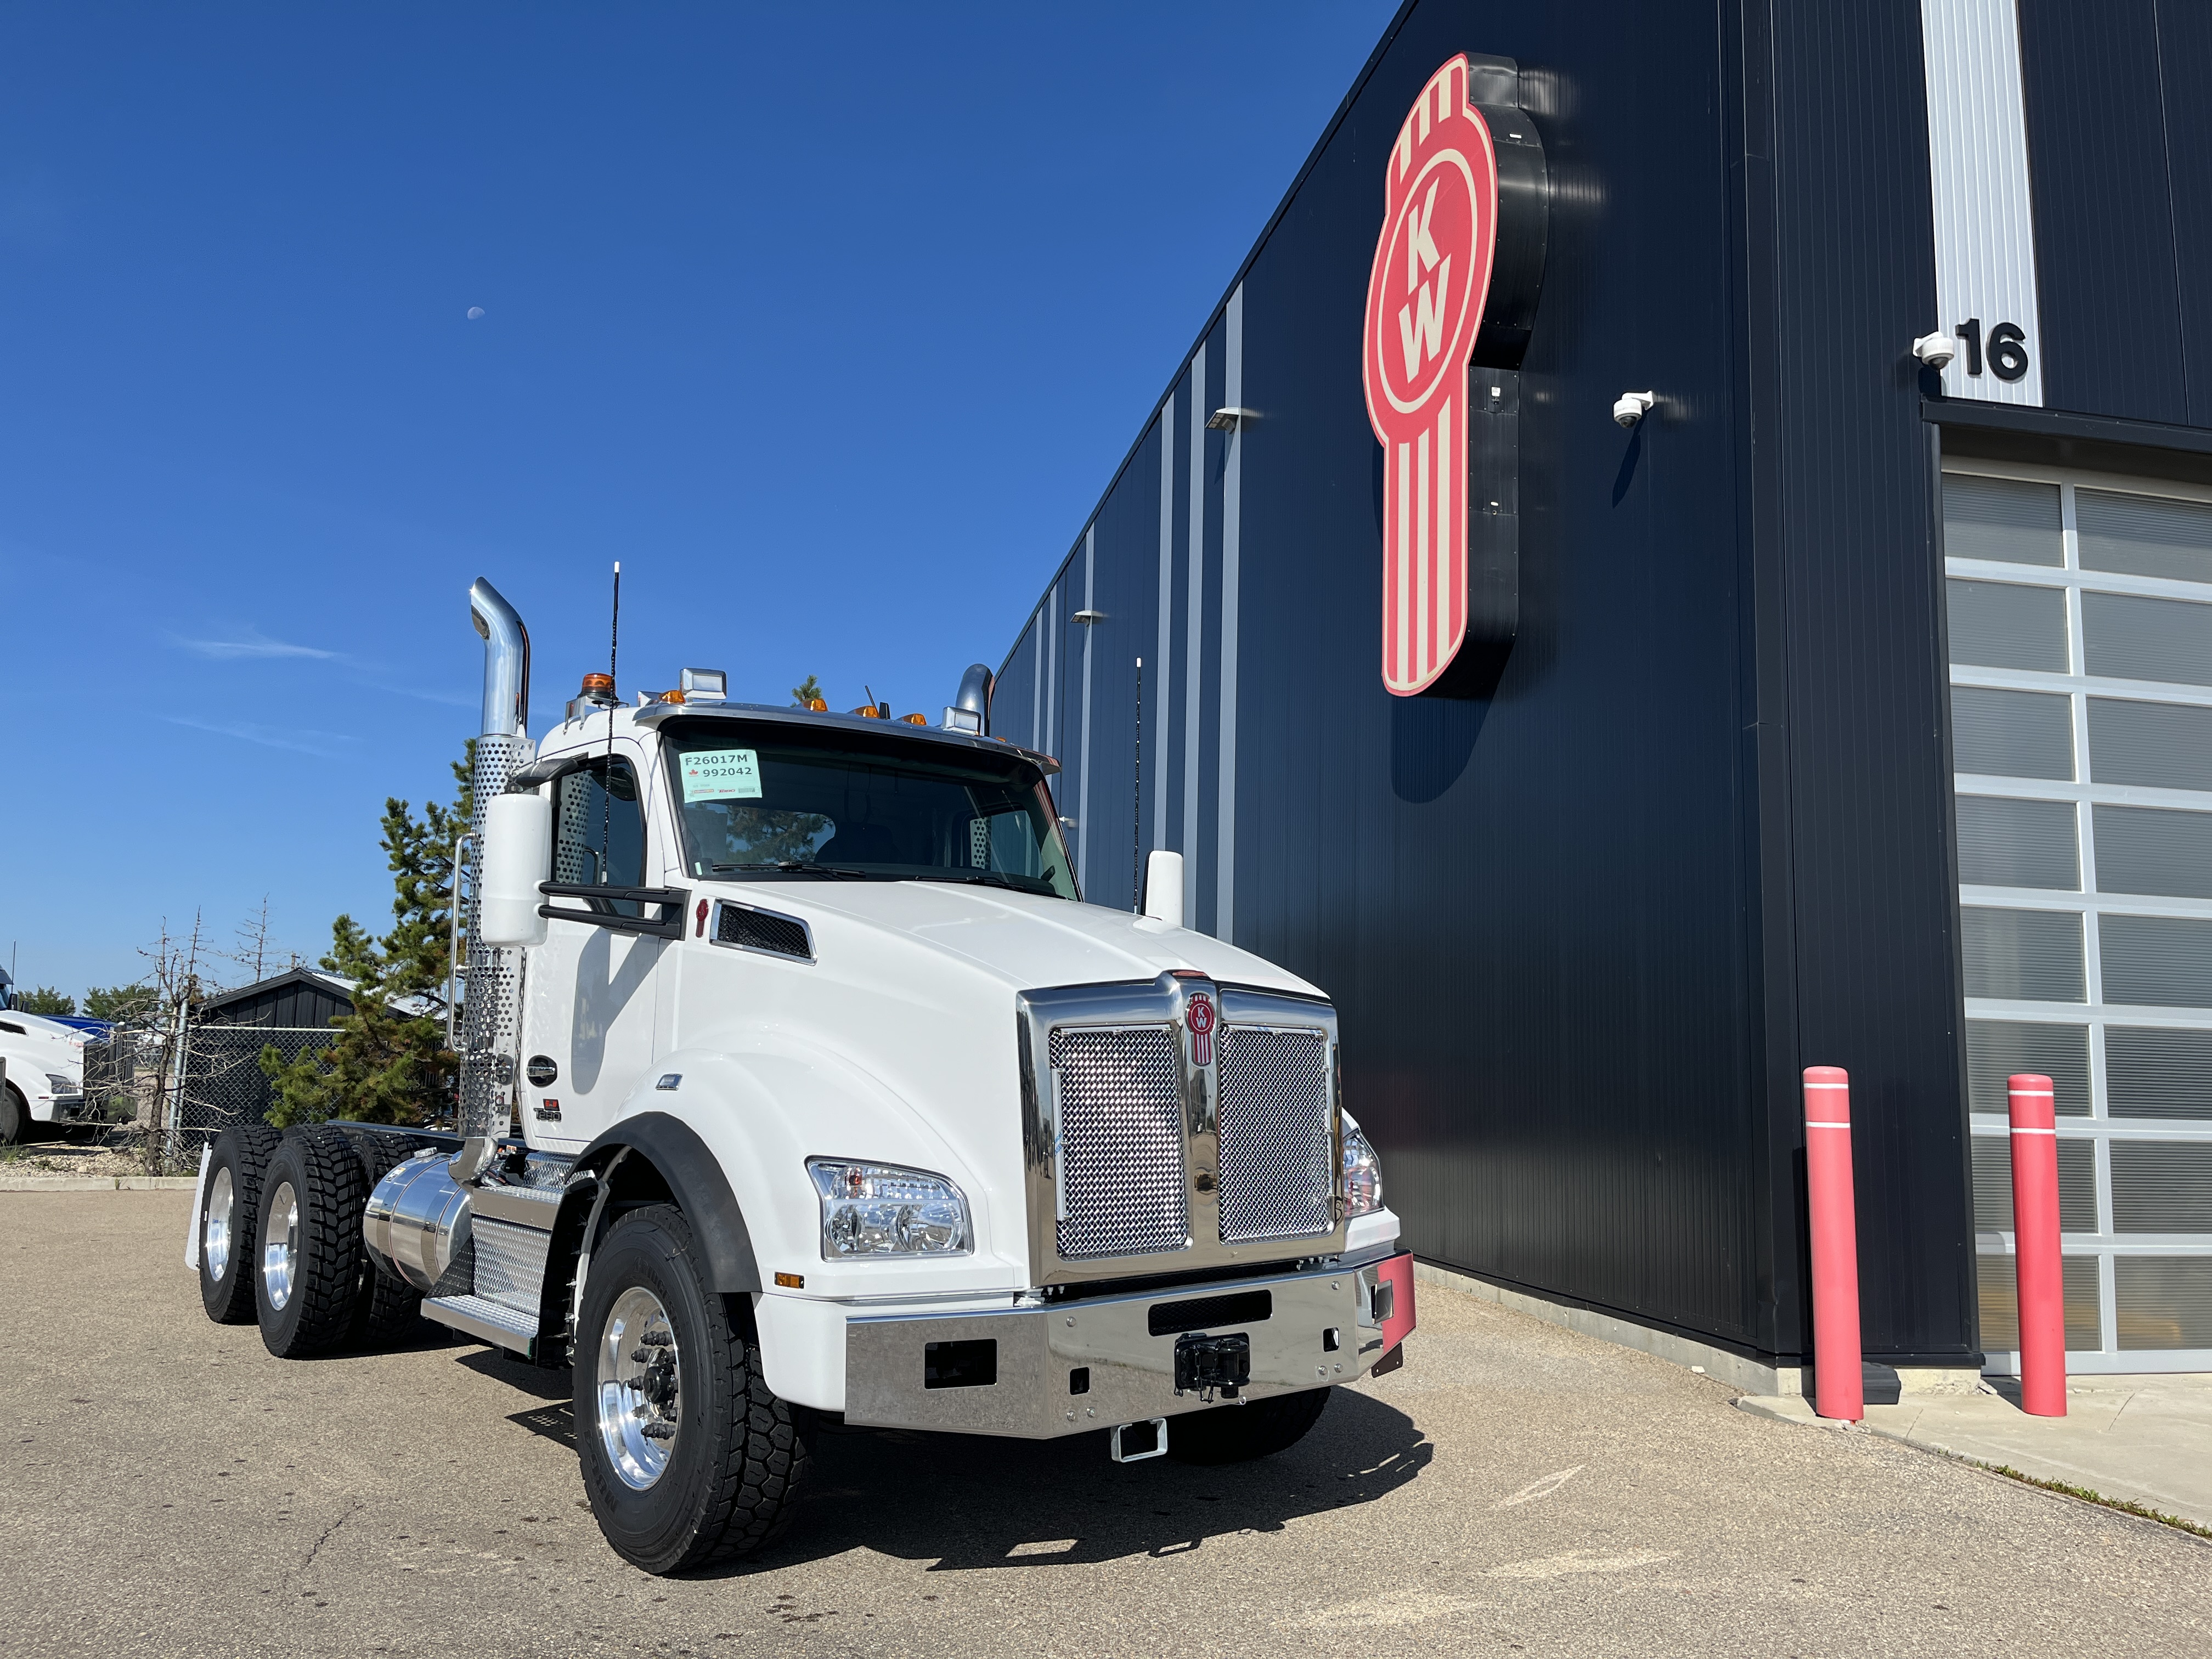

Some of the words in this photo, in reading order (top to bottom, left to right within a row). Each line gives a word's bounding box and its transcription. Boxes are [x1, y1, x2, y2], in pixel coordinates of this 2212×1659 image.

[1955, 318, 2028, 384] 16
[686, 754, 747, 766] F26017M
[703, 767, 752, 777] 992042
